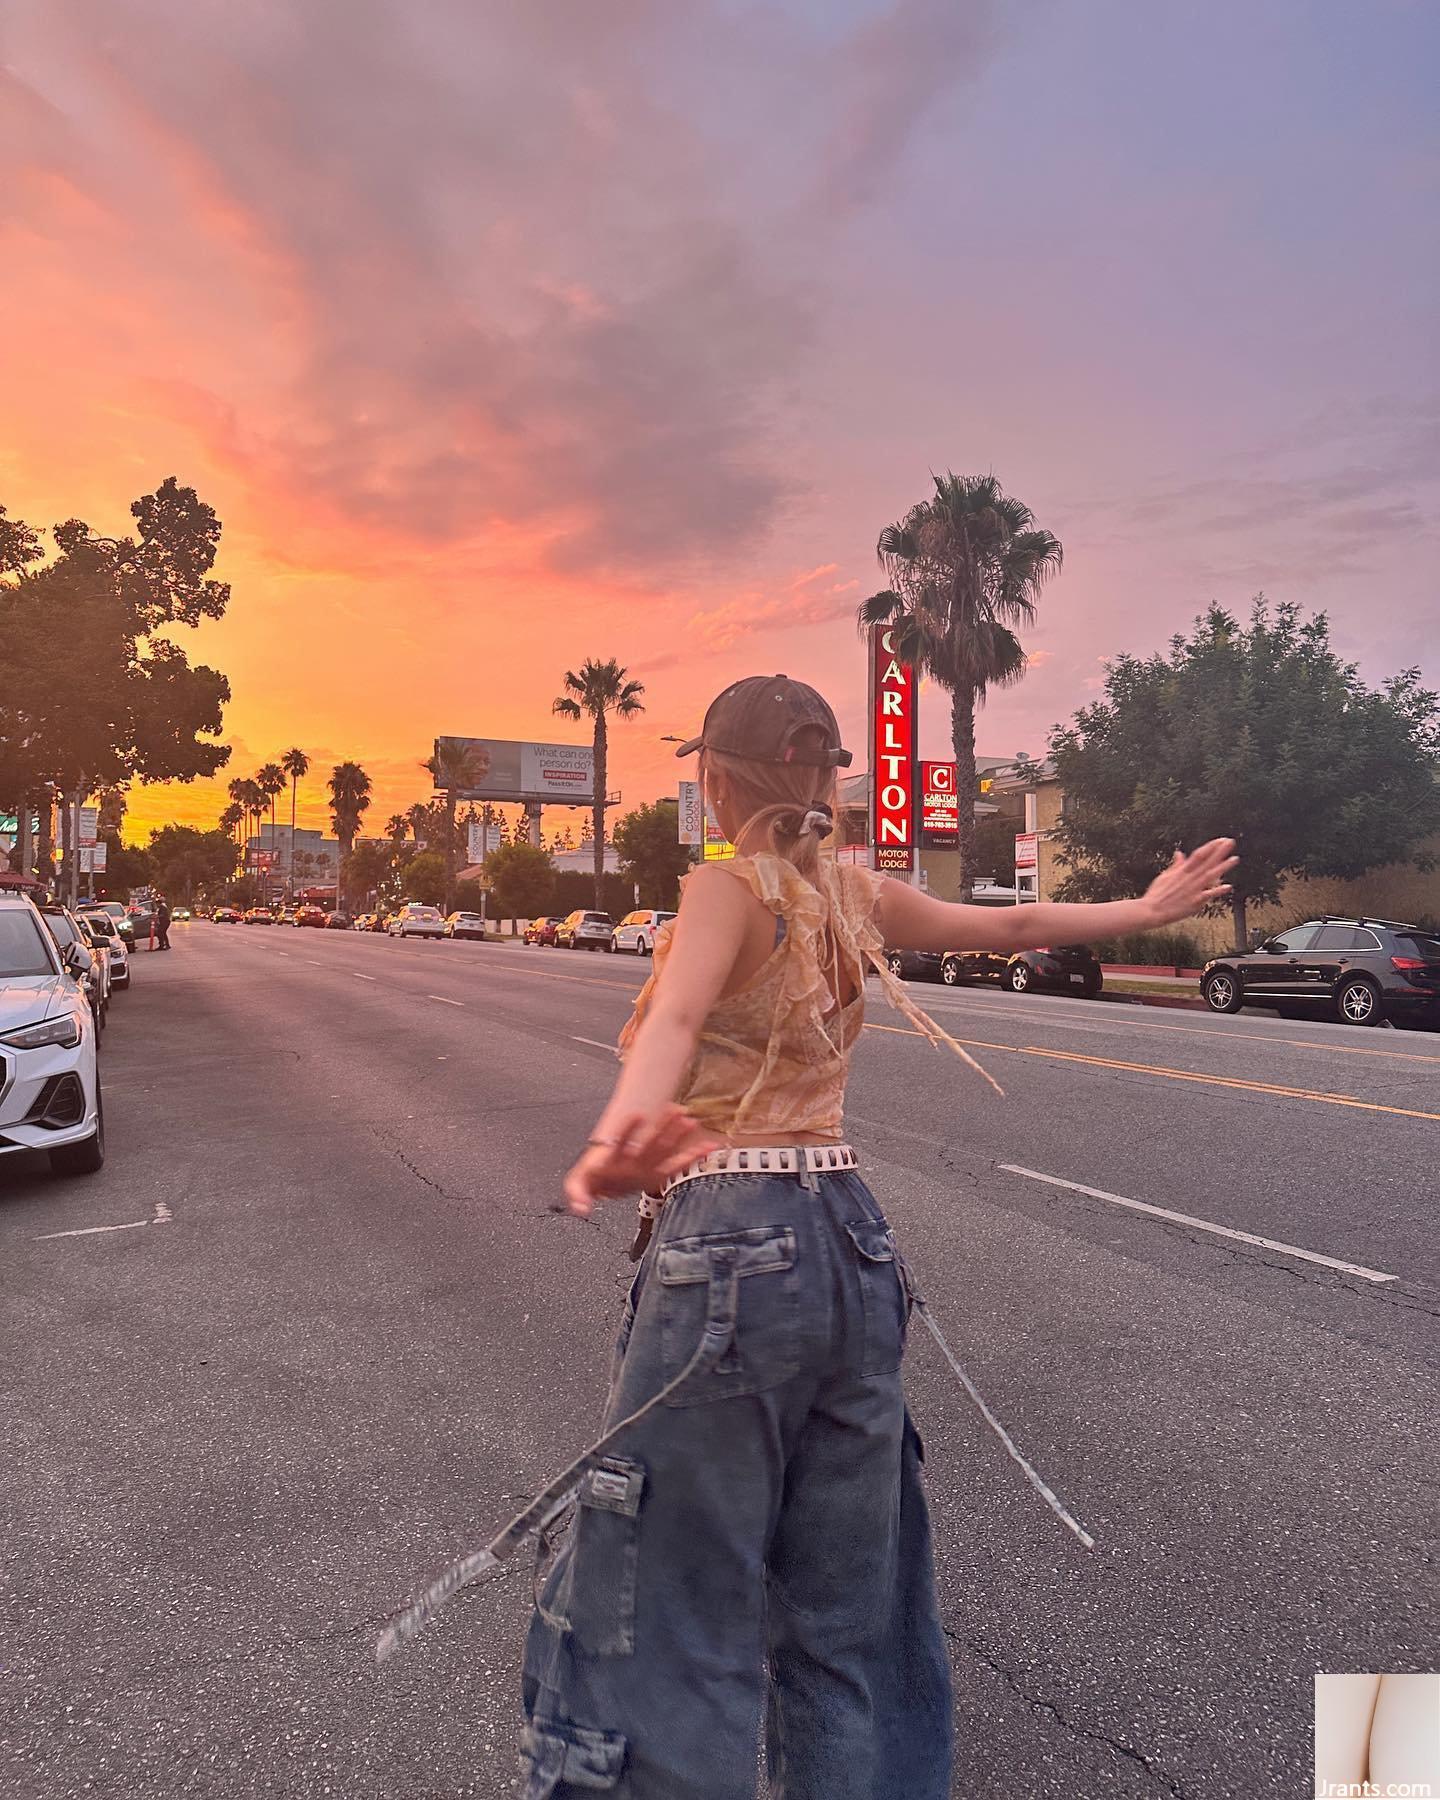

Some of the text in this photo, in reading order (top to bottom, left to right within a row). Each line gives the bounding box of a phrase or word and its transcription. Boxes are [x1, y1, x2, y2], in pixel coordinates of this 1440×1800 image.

[881, 630, 908, 843] CARLTON
[533, 746, 557, 758] What
[559, 750, 577, 759] can
[540, 759, 591, 770] person do?
[544, 771, 586, 780] INSPIRATION
[932, 768, 949, 789] C
[924, 793, 958, 804] CARLTON
[685, 782, 694, 832] COUNTRY
[878, 849, 909, 859] MOTOR
[880, 859, 908, 869] LODGE
